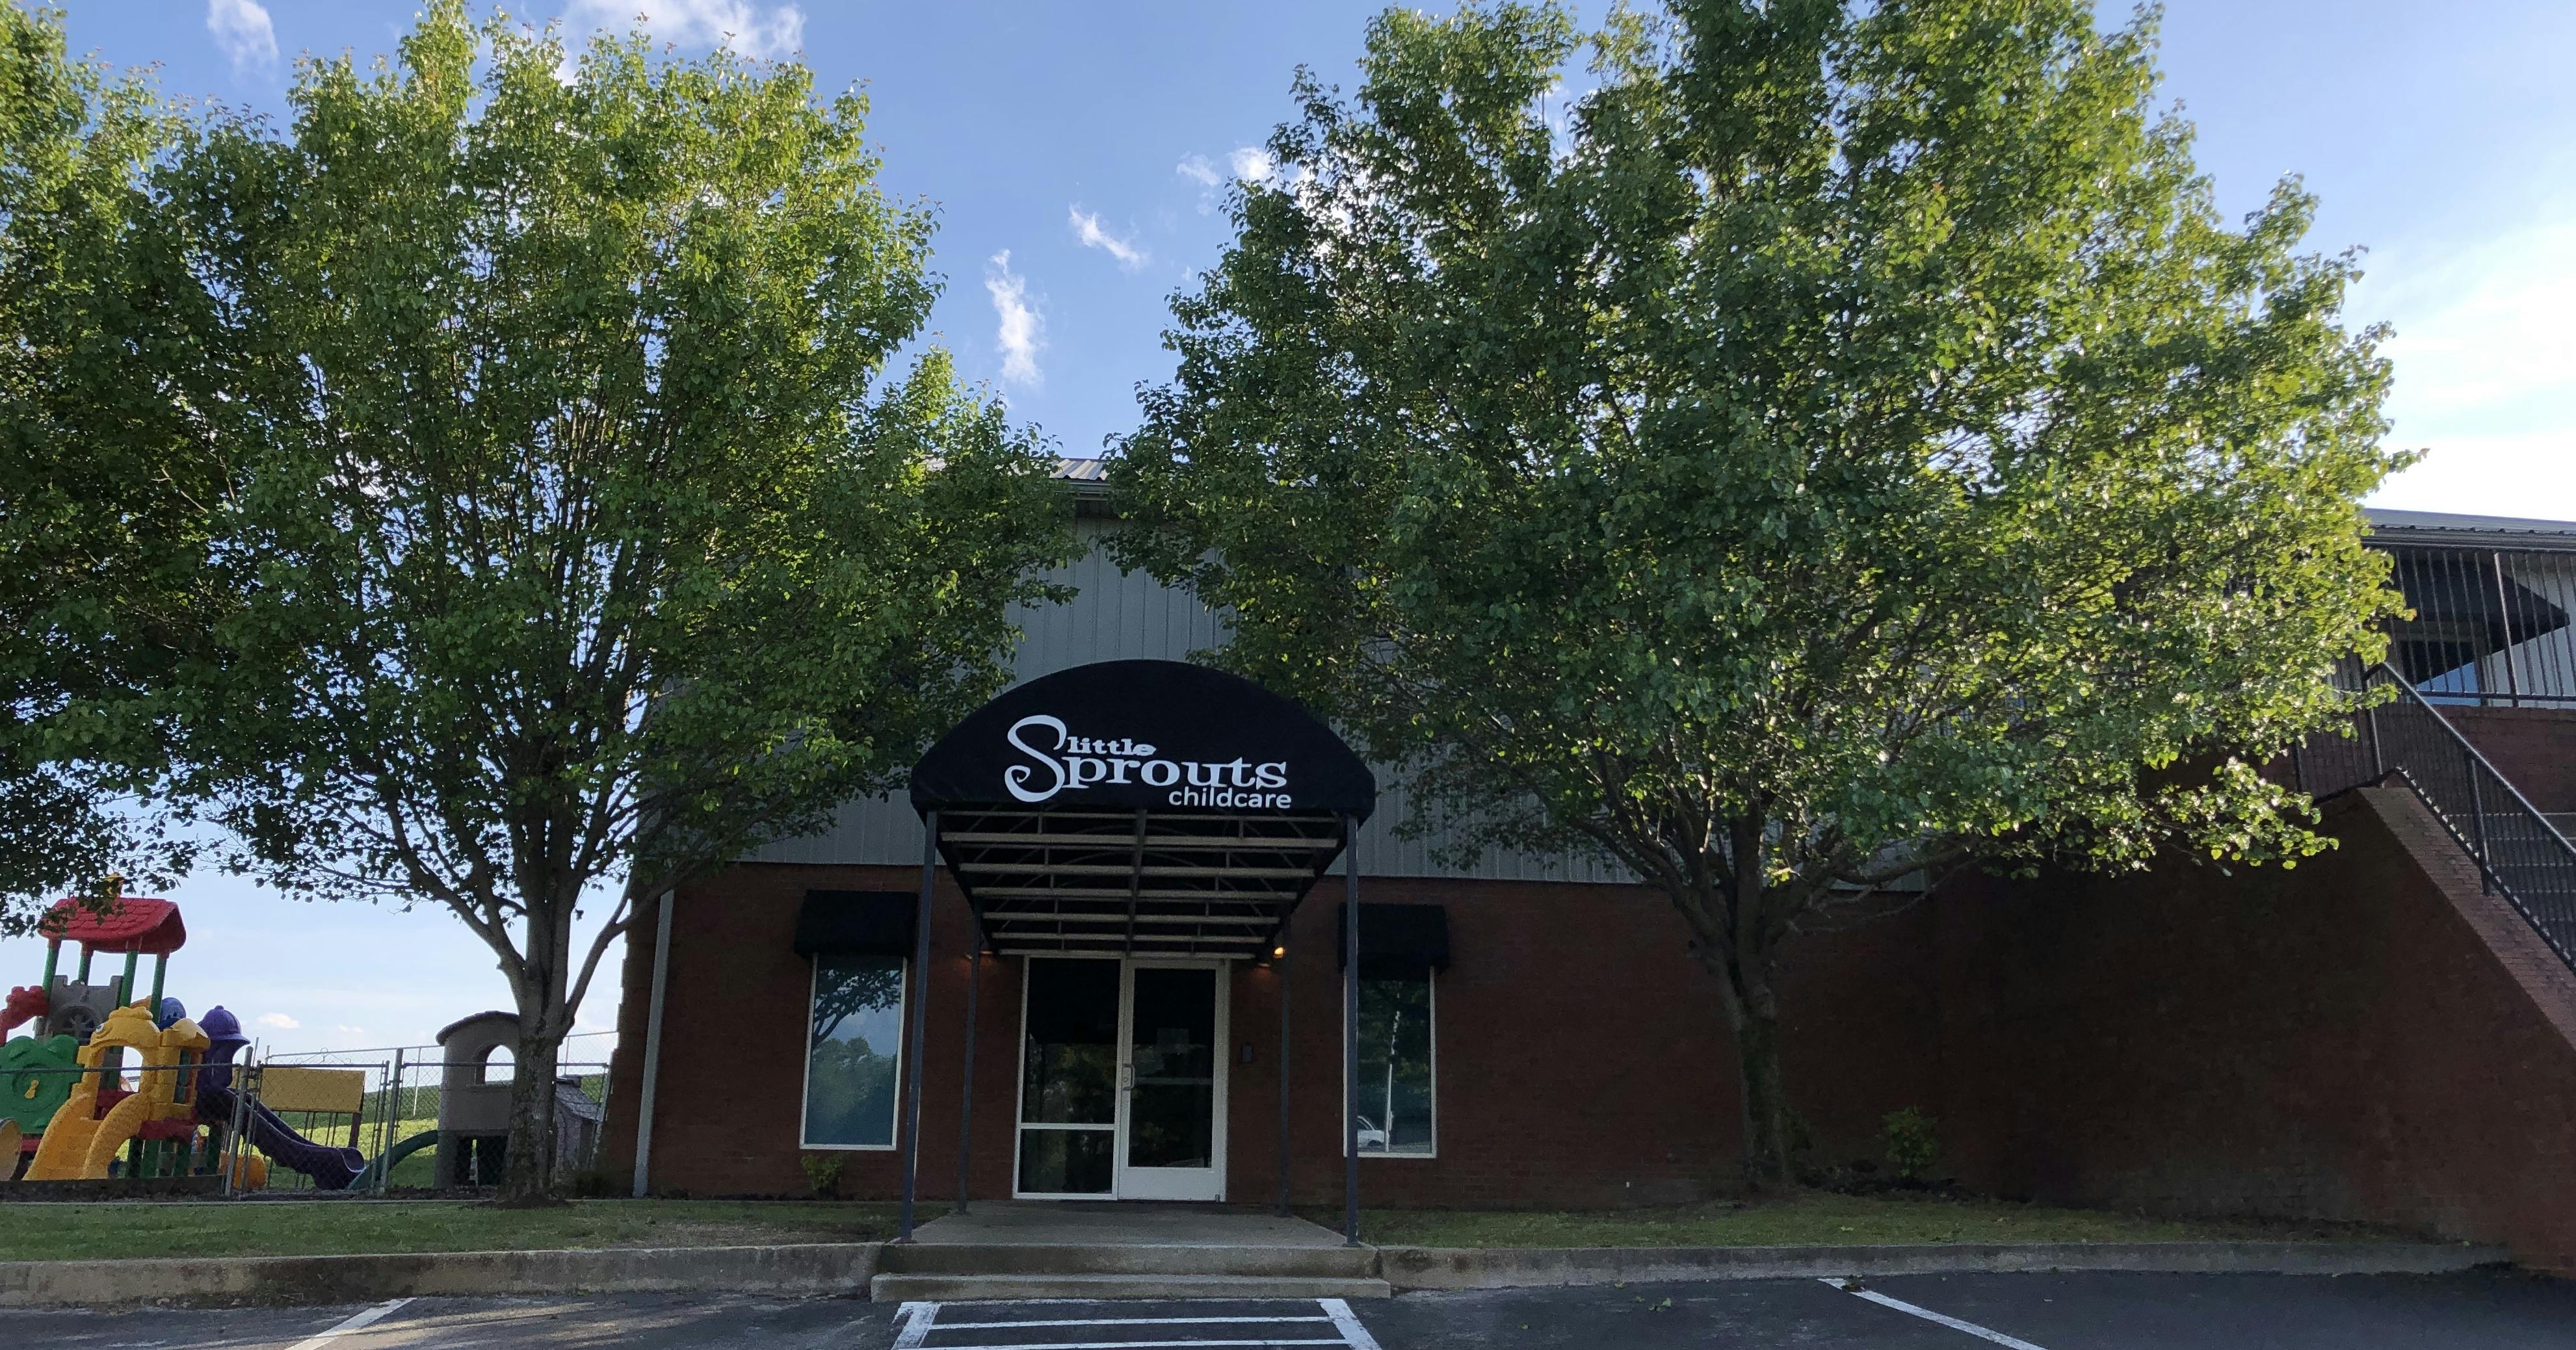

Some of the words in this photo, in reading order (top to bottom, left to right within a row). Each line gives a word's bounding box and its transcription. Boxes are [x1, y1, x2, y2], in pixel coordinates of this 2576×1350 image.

[1067, 736, 1156, 756] little
[1005, 714, 1287, 802] Sprouts
[1168, 786, 1292, 809] childcare
